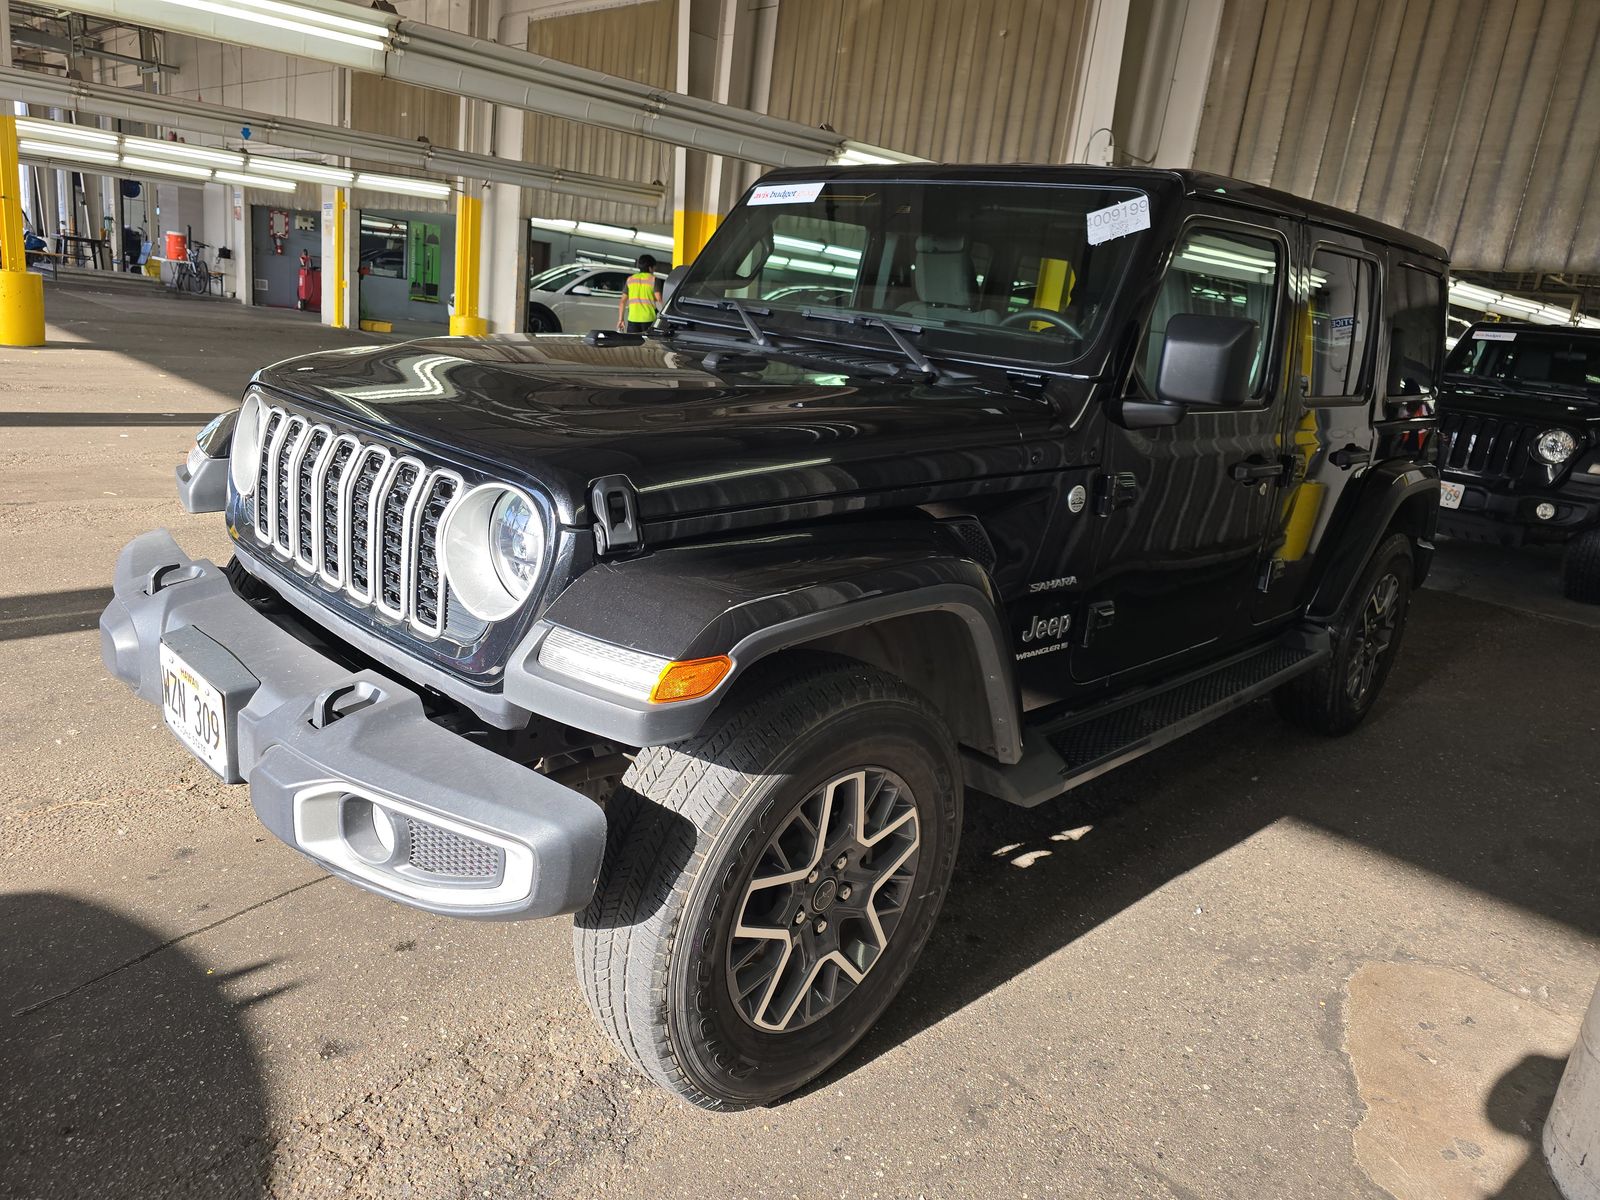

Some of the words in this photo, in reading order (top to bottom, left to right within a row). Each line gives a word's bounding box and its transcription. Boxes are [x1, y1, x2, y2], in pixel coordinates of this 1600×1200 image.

[769, 190, 797, 200] budget
[1029, 575, 1078, 593] SAHARA
[1022, 613, 1072, 643] Jeep
[1015, 643, 1061, 661] WRANGLER
[161, 664, 187, 723] WZN
[193, 693, 220, 751] 309
